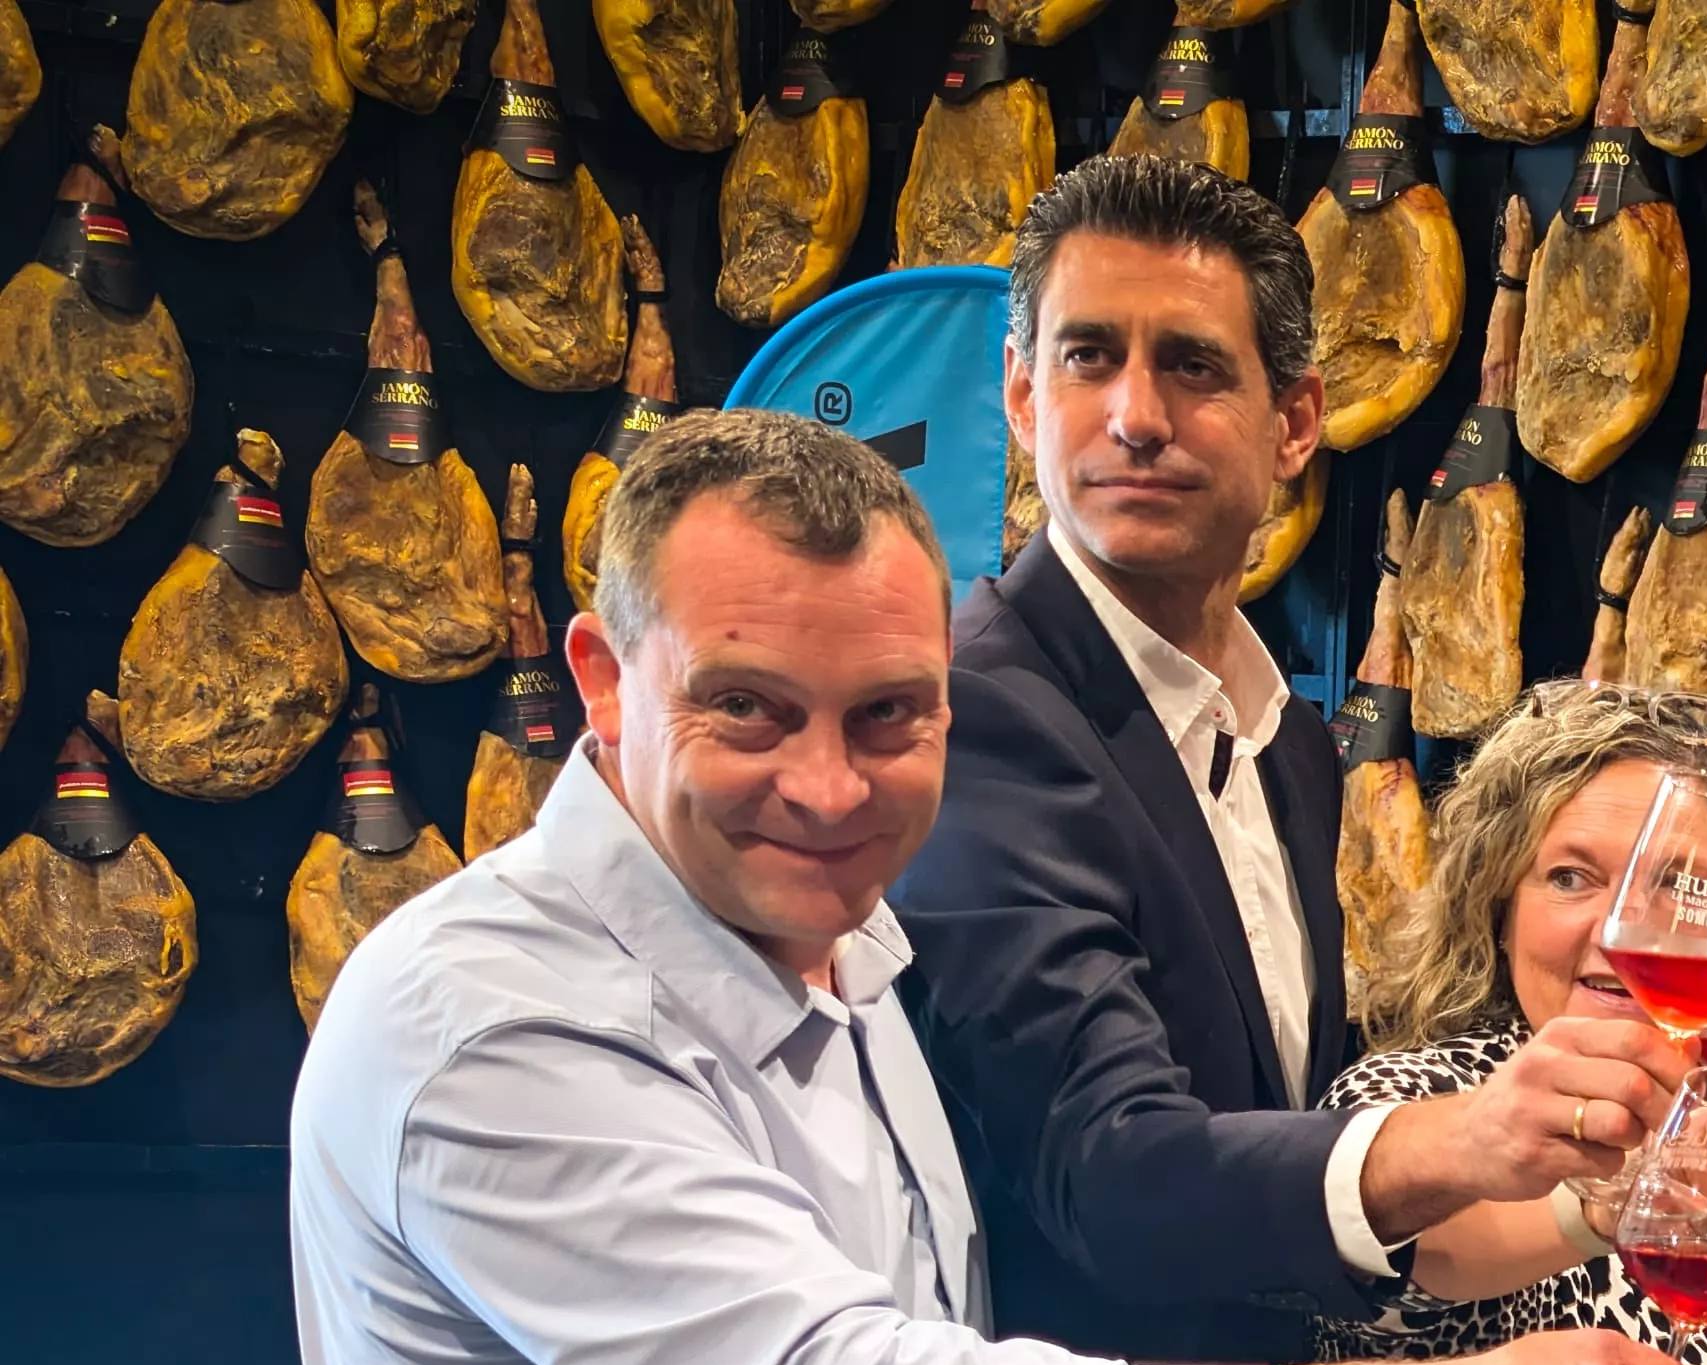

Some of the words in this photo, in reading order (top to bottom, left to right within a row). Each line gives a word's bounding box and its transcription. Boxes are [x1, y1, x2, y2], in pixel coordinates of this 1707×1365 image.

[1352, 127, 1397, 140] JAMÓN
[381, 381, 430, 397] JAMÓN
[371, 392, 438, 410] SERRANO
